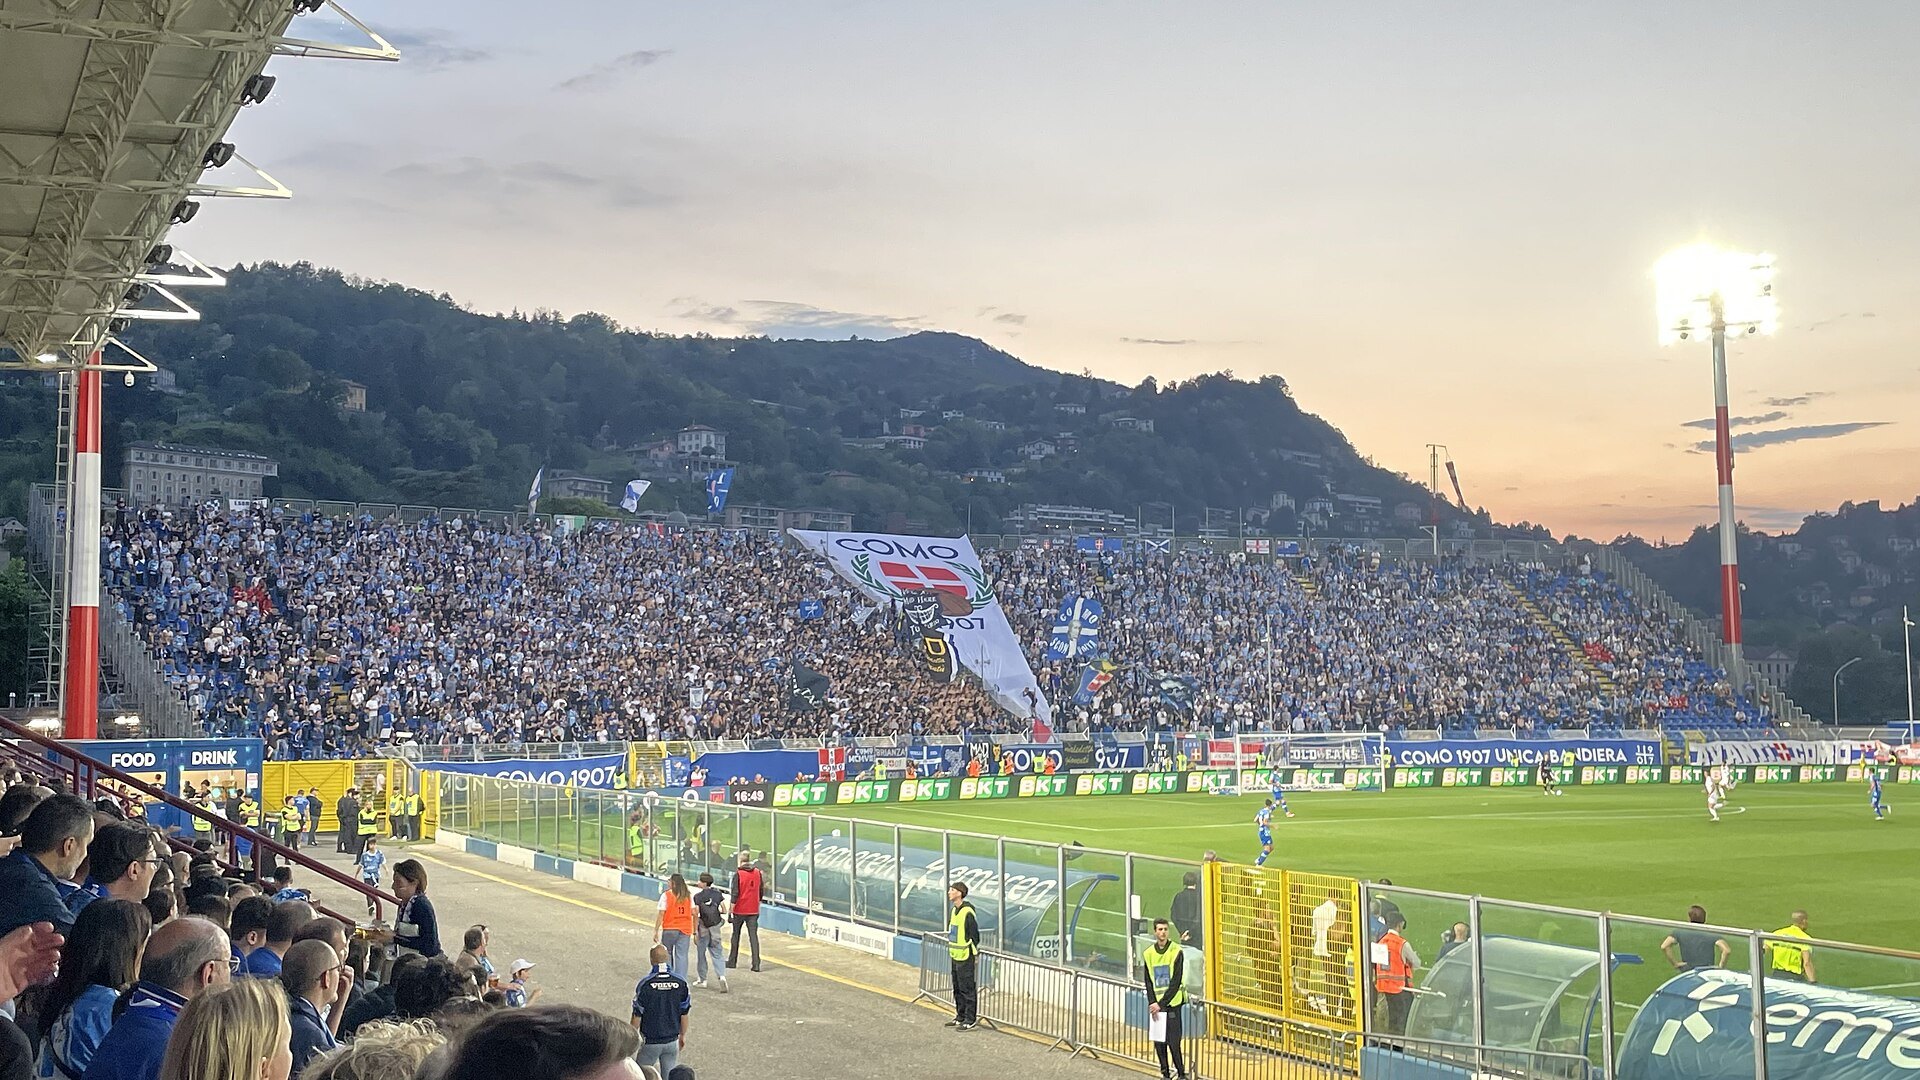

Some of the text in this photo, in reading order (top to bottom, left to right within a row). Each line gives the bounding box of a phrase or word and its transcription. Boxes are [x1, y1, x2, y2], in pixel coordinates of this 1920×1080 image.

[835, 538, 959, 560] COMO
[111, 752, 156, 768] FOOD
[191, 750, 238, 765] DRINK
[876, 748, 906, 758] BRIANZA
[1401, 748, 1453, 765] COMO
[1456, 749, 1491, 764] 1907
[494, 770, 566, 790] COMO
[570, 765, 617, 788] 1907
[1187, 773, 1231, 789] BKT
[1293, 772, 1335, 787] BKT
[1394, 770, 1434, 785] BKT
[1442, 770, 1482, 784] BKT
[1491, 769, 1528, 783] BKT
[1582, 768, 1618, 782] BKT
[1626, 767, 1662, 781] BKT
[1670, 767, 1702, 781] BKT
[1755, 767, 1791, 781] BKT
[1800, 767, 1835, 780] BKT
[1900, 767, 1920, 780] BK
[900, 782, 950, 798] BKT
[961, 780, 1009, 796] BKT
[1019, 778, 1066, 795] BKT
[1076, 777, 1122, 793] BKT
[1132, 775, 1178, 792] BKT
[734, 790, 765, 802] 16:49
[774, 786, 826, 802] BKT
[838, 784, 889, 800] BKT
[1036, 939, 1068, 949] COM
[1040, 949, 1060, 958] 190
